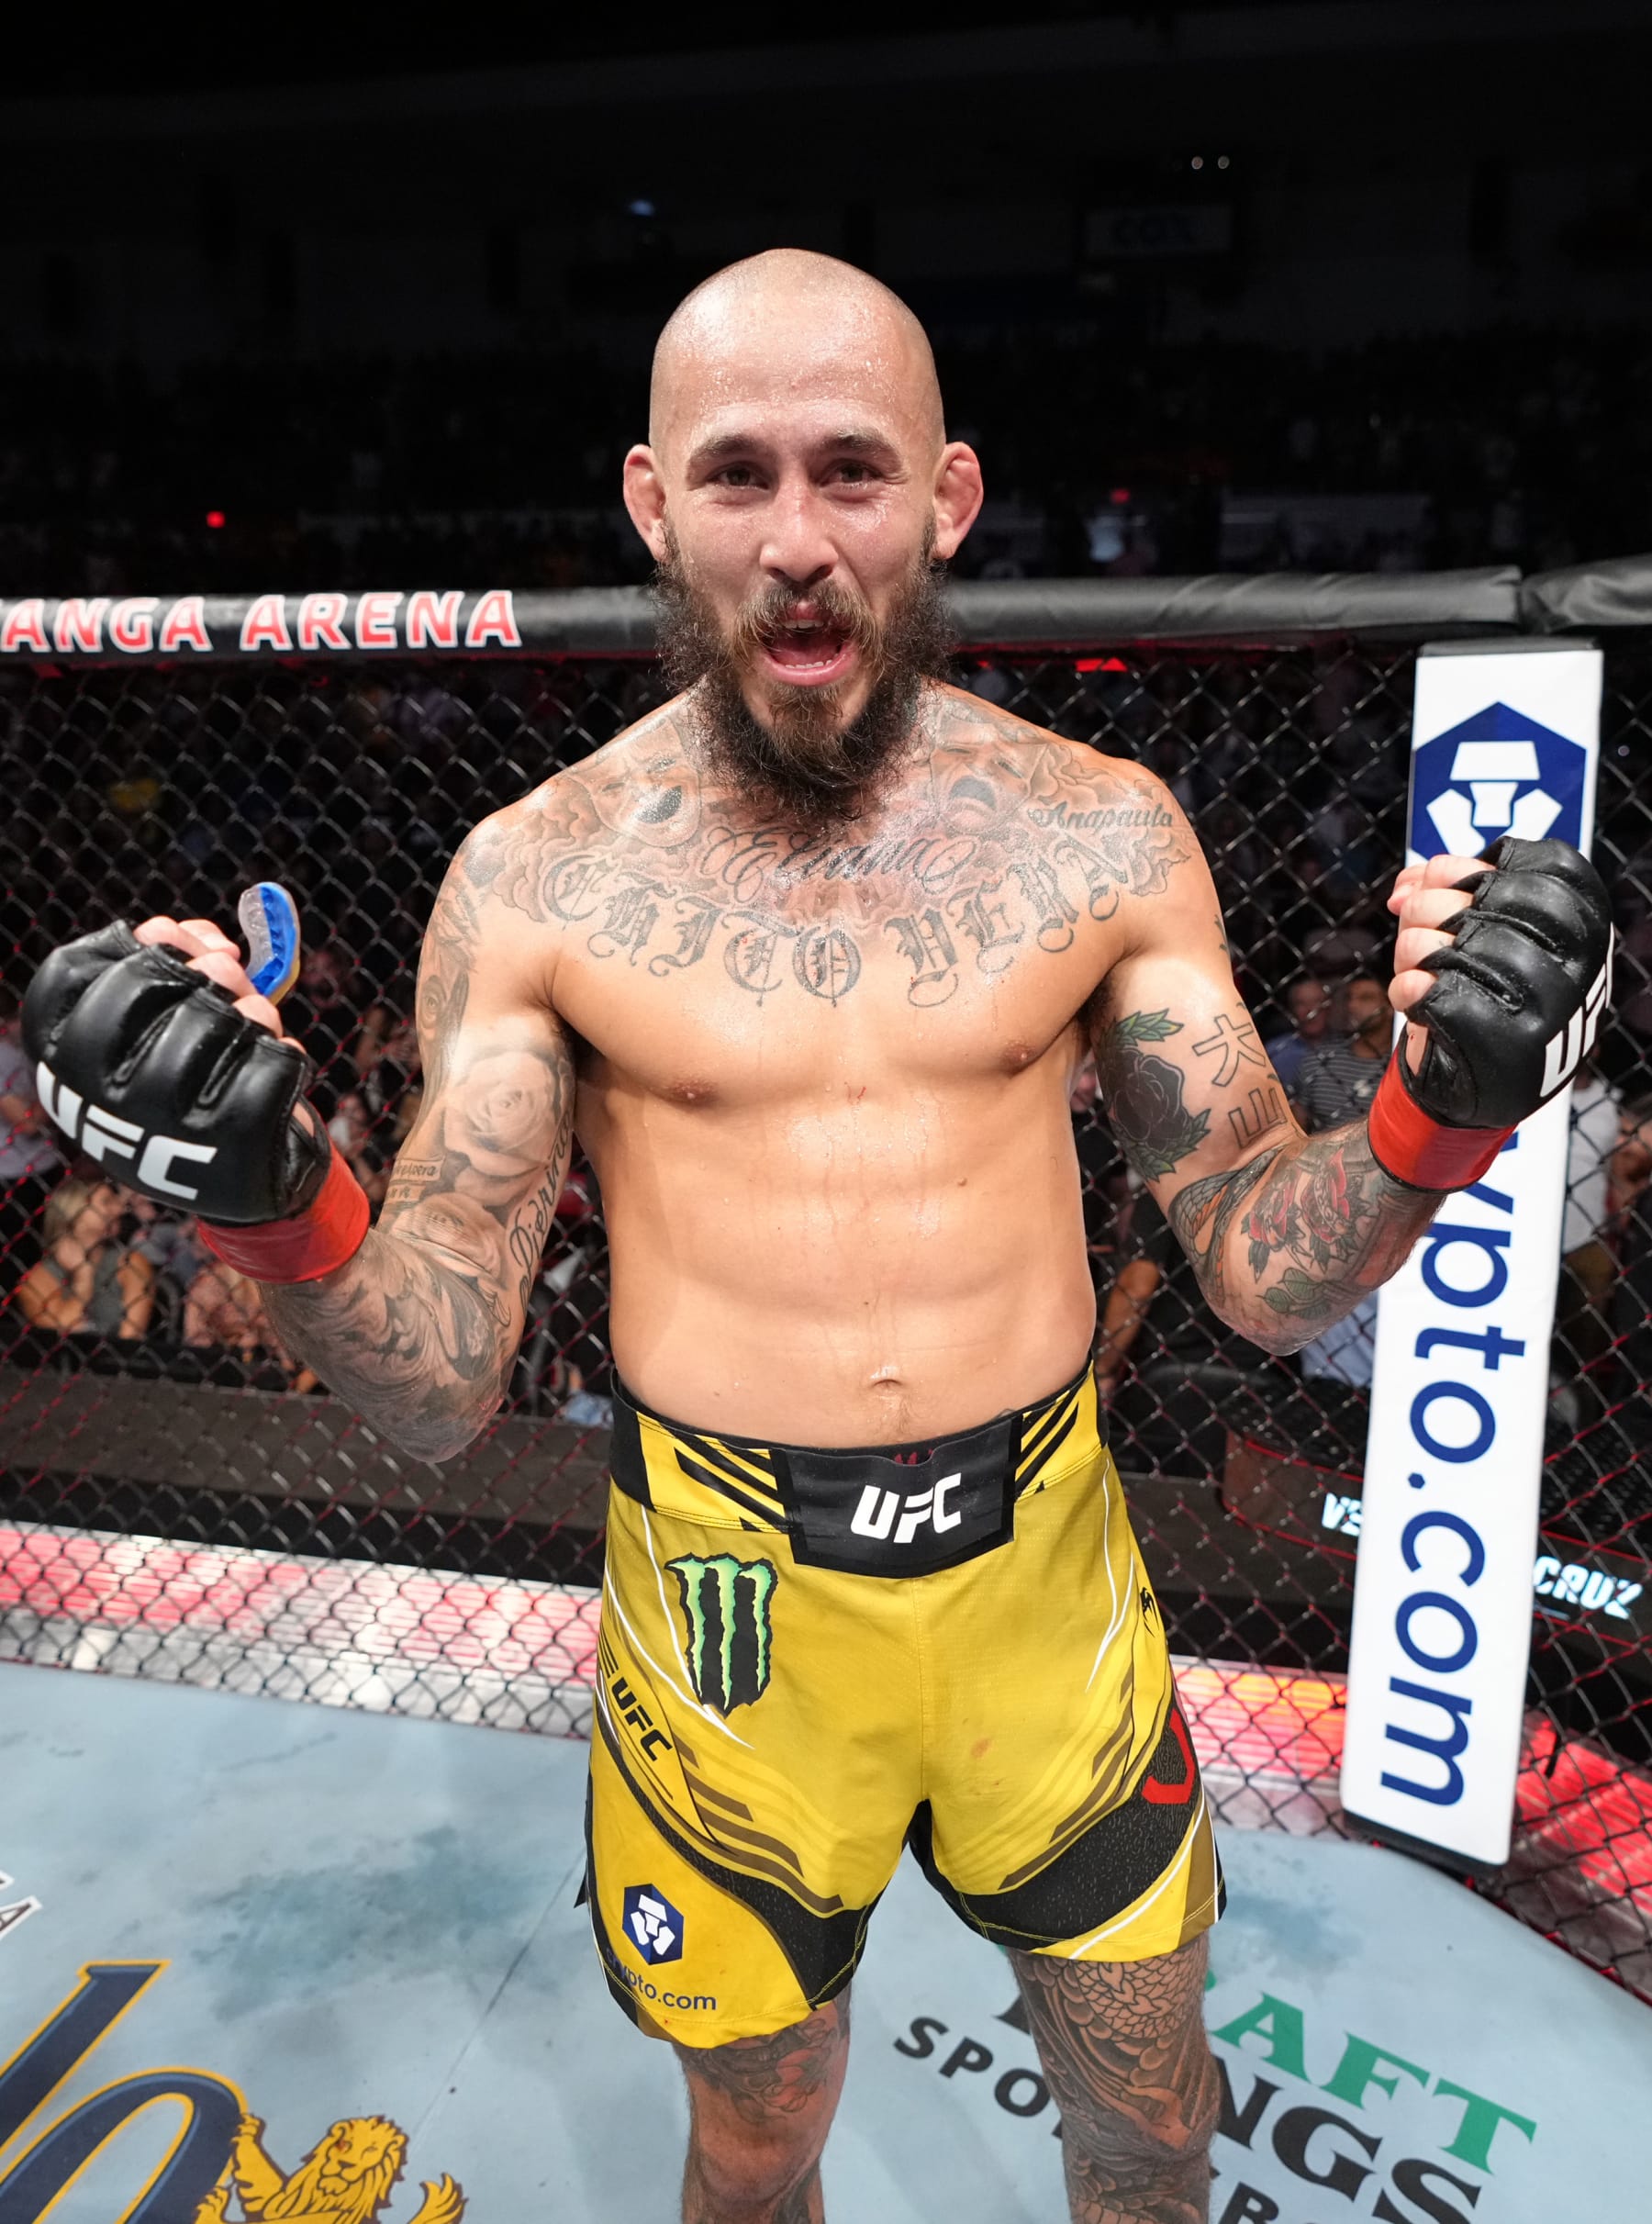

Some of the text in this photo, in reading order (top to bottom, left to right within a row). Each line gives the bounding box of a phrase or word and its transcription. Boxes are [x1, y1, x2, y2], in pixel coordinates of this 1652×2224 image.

[0, 589, 523, 653] ANGA ARENA
[36, 1061, 218, 1201] UFC
[851, 1472, 962, 1544] UFC
[1533, 1556, 1642, 1619] CRUZ
[611, 1677, 674, 1761] UFC
[606, 1947, 717, 2011] crypto.com
[1205, 1971, 1537, 2175] AFT
[1216, 2054, 1482, 2224] NGS
